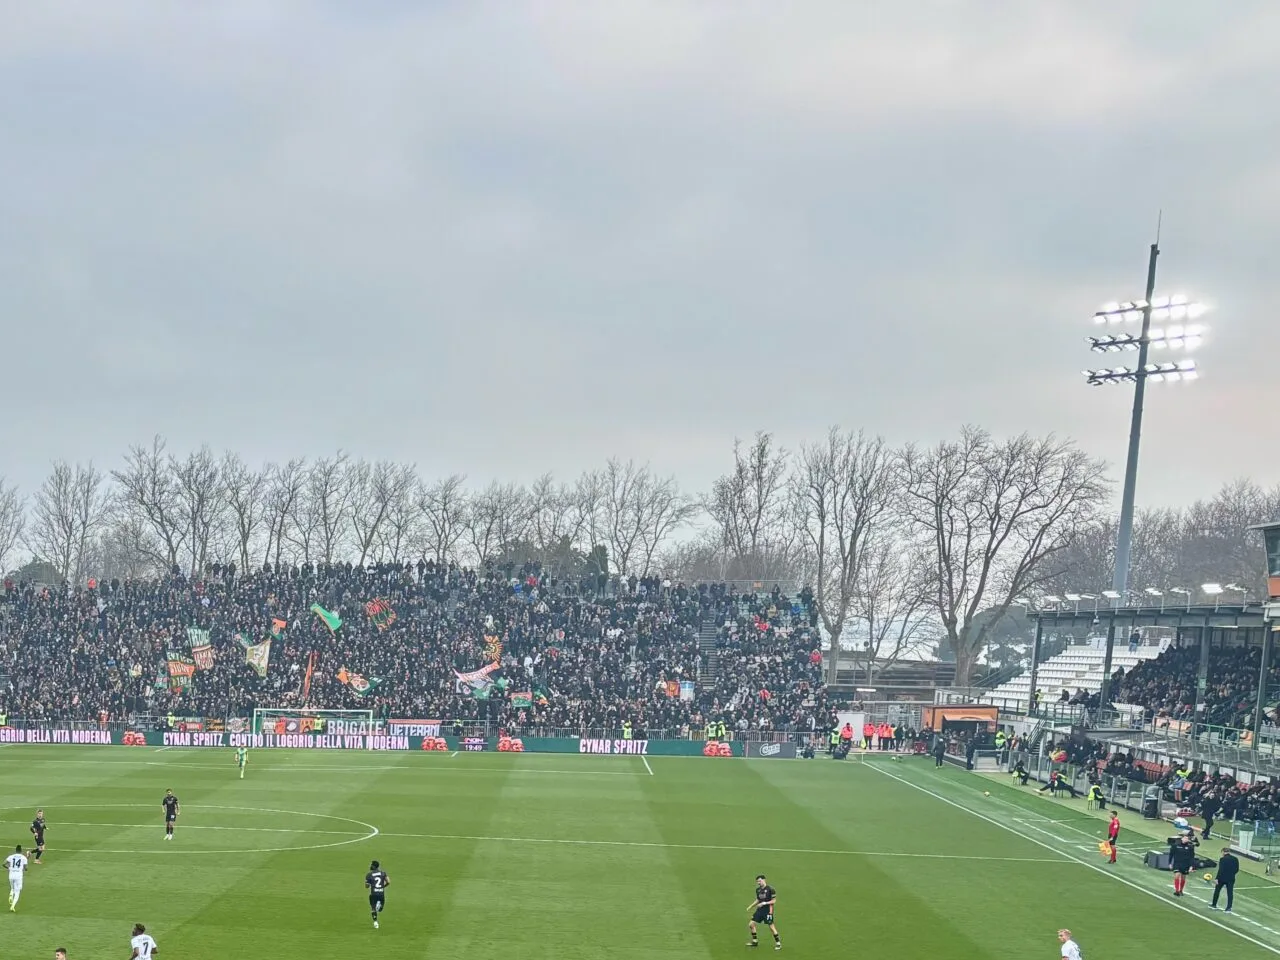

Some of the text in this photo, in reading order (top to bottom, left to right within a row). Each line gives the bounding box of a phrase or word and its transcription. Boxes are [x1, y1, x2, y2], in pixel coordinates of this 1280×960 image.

[27, 729, 50, 743] DELLA
[53, 730, 69, 743] VITA
[72, 730, 111, 744] MODERNA
[163, 732, 190, 746] CYNAR
[266, 734, 273, 748] IL
[276, 734, 313, 748] LOGORIO
[316, 735, 343, 749] DELLA
[344, 735, 363, 749] VITA
[367, 735, 409, 750] MODERNA
[580, 739, 648, 755] CYNAR SPRITZ
[12, 858, 22, 869] 14
[374, 876, 382, 888] 2
[142, 941, 149, 956] 7
